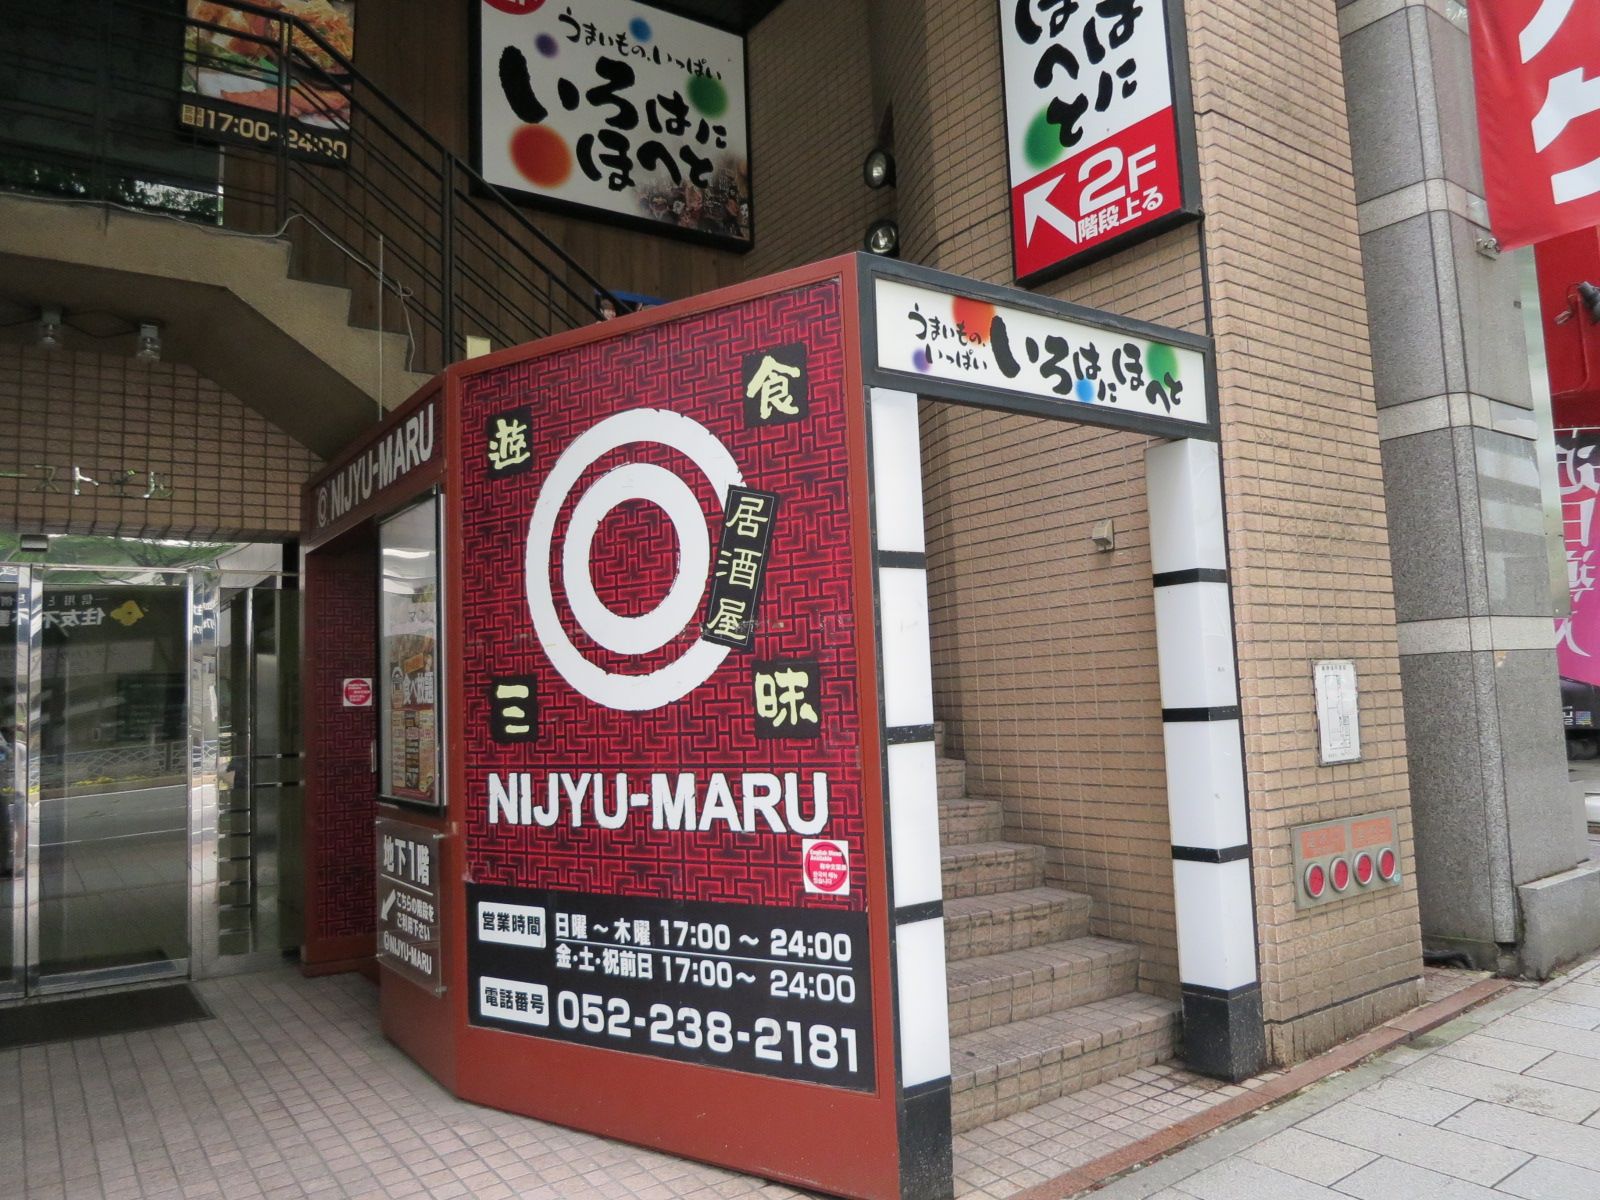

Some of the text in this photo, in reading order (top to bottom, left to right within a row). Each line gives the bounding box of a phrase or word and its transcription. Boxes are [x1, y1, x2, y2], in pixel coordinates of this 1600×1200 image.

[499, 45, 727, 149] いろはに
[576, 129, 714, 191] ほへと
[1077, 145, 1156, 217] 2F
[1078, 186, 1164, 243] 階段上る
[747, 355, 800, 420] 食
[926, 344, 987, 371] いっぱい
[990, 314, 1184, 414] いろはにほへと
[331, 402, 434, 521] NIJYU-MARU
[488, 418, 531, 470] 遊
[706, 496, 768, 642] 居酒屋
[496, 684, 530, 734] 三
[488, 772, 829, 835] NIJYU-MARU
[383, 834, 430, 886] 地下1階
[482, 910, 541, 937] 営業時間
[485, 987, 545, 1014] 電話番号
[557, 990, 858, 1073] 052-238-2181
